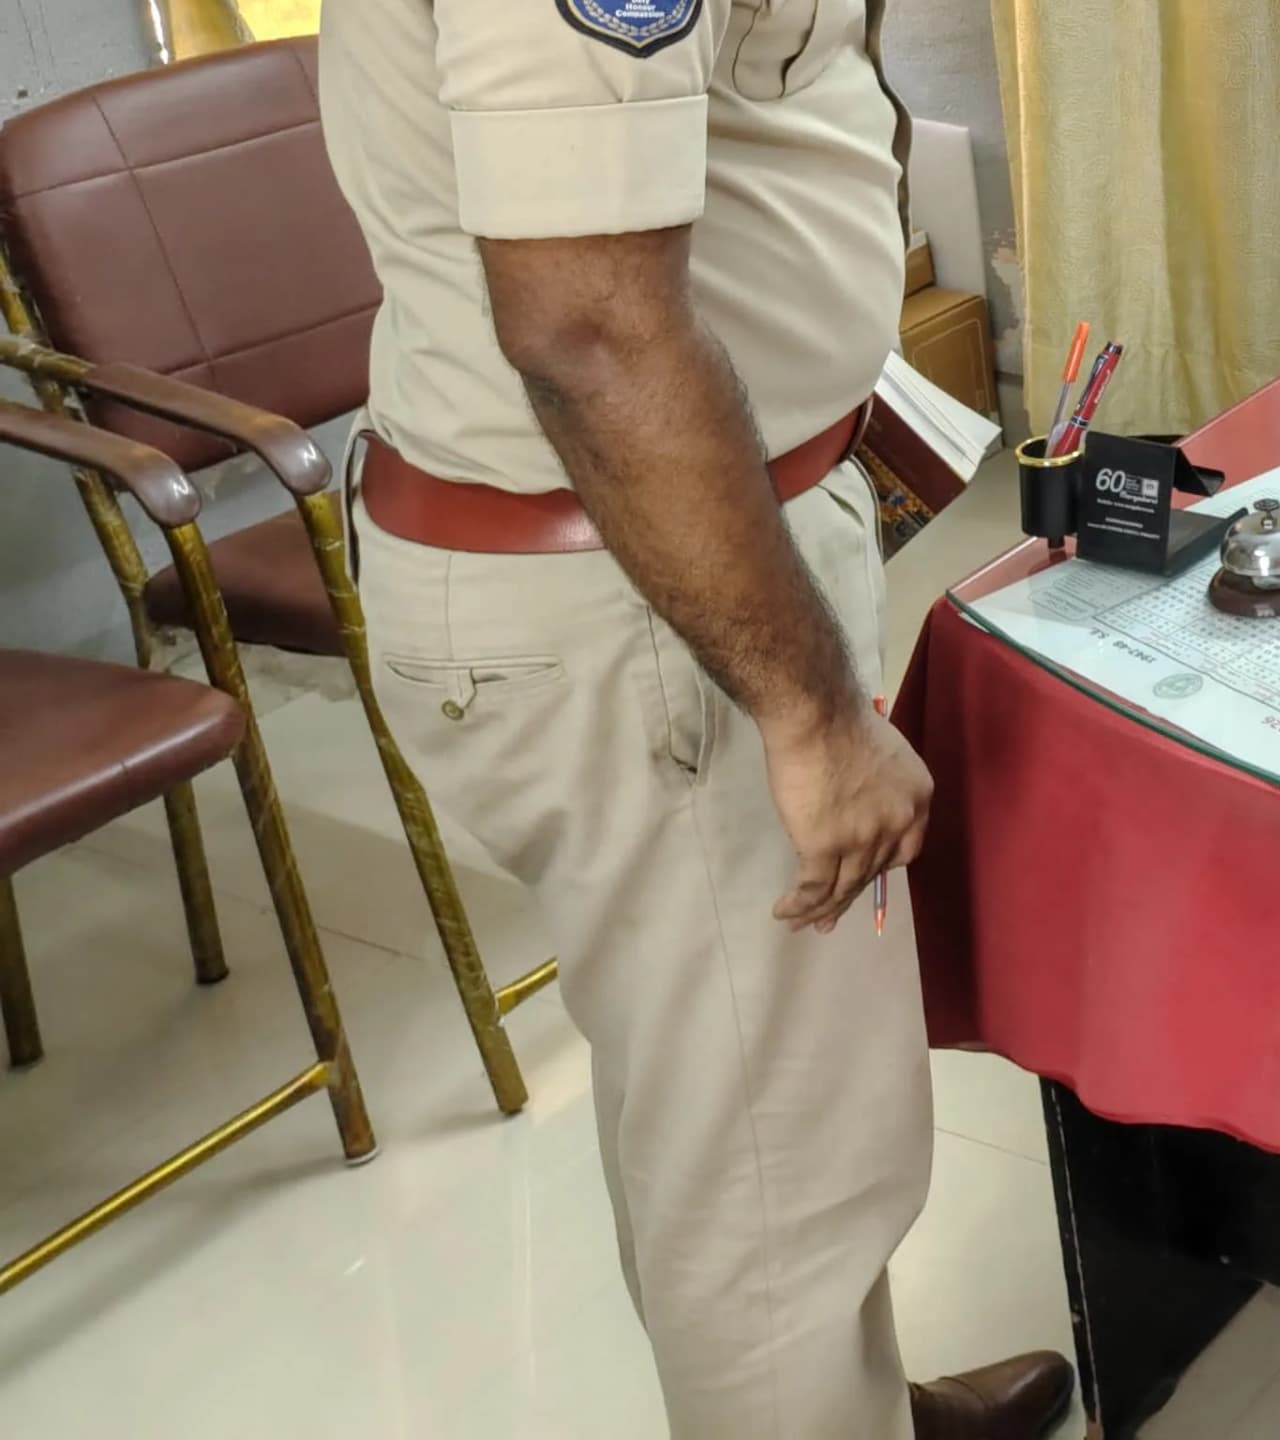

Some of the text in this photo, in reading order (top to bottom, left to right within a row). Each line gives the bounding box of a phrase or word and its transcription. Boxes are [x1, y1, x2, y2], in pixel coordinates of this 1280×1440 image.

[626, 3, 656, 11] Honour
[615, 10, 664, 18] Compassion
[1096, 468, 1126, 492] 60
